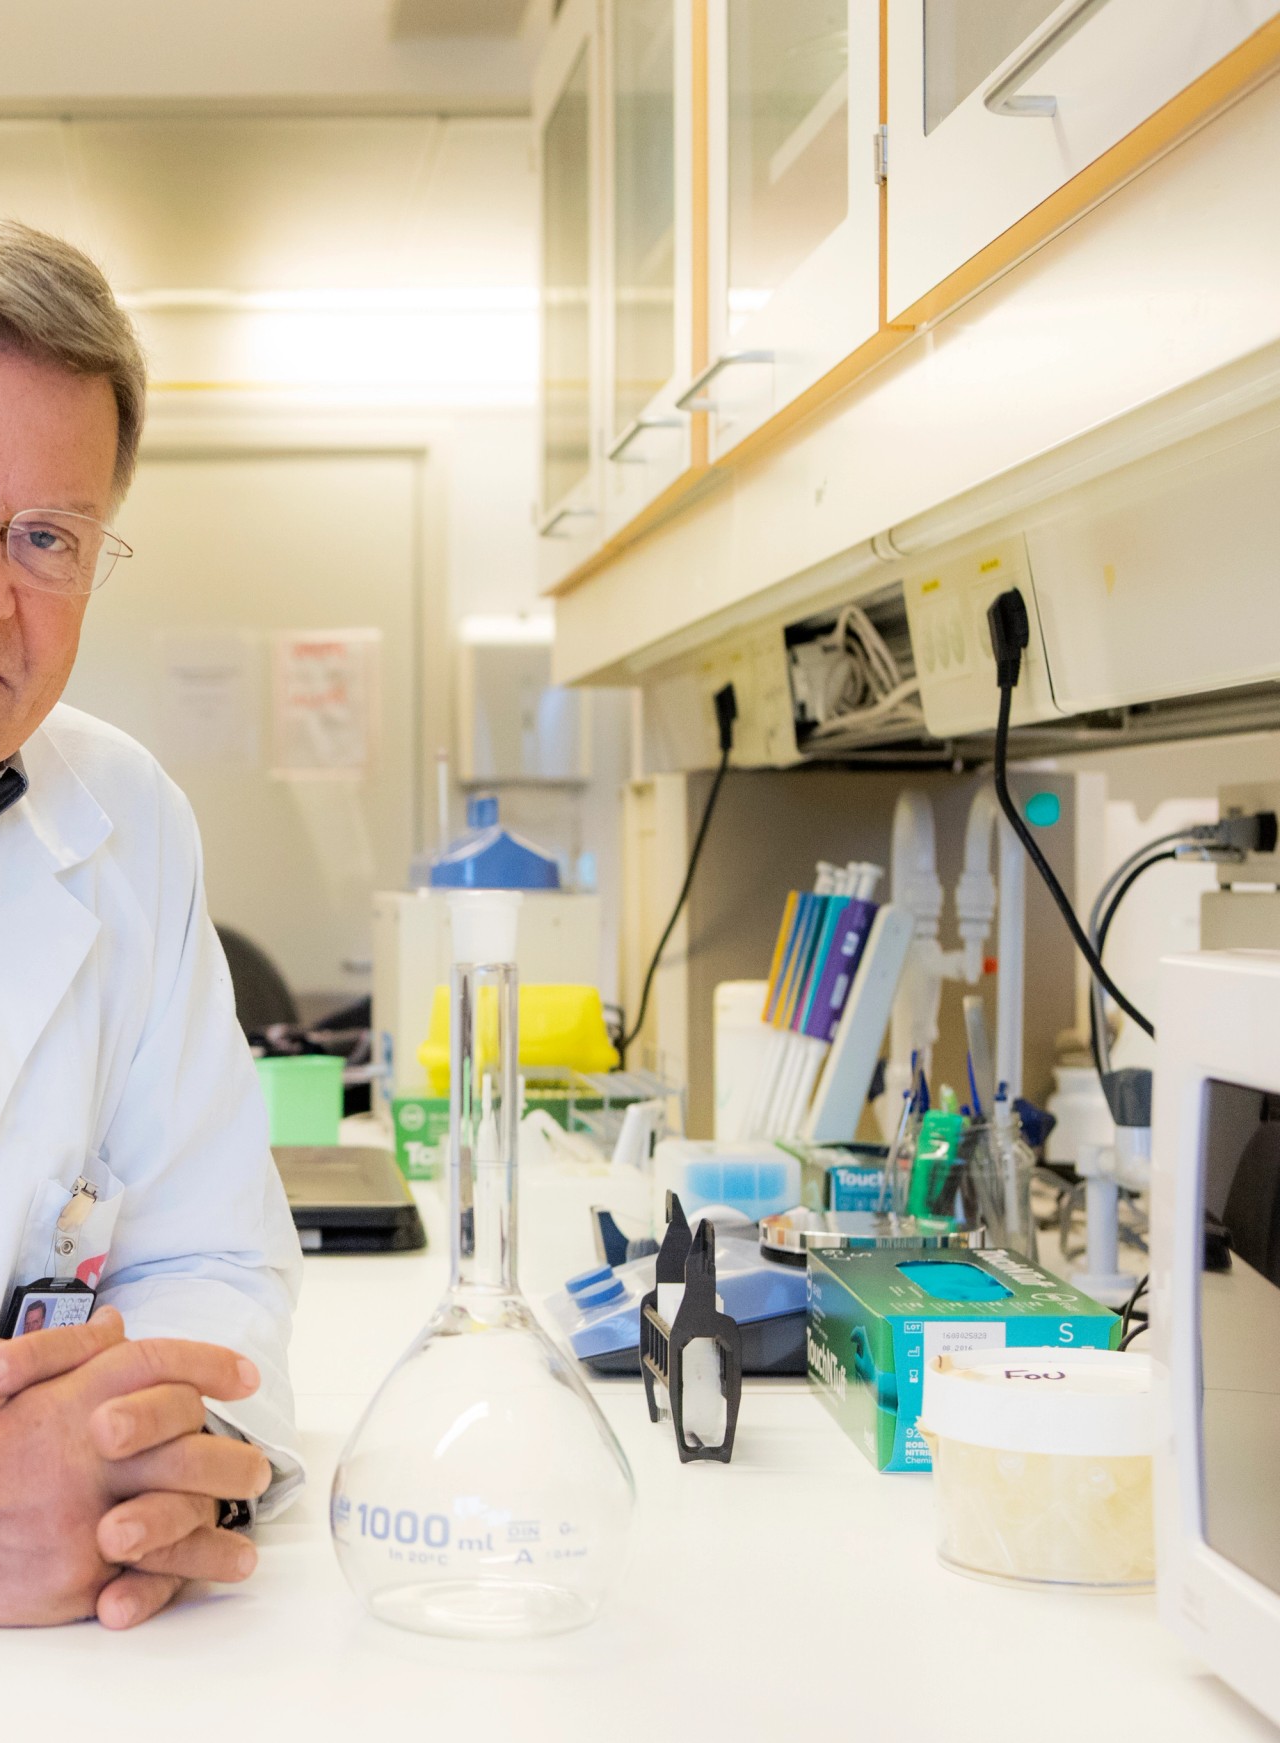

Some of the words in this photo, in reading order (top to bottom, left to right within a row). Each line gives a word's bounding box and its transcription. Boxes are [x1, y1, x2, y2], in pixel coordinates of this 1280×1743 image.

[1058, 1322, 1074, 1343] S
[905, 1456, 933, 1464] Chemi
[358, 1503, 450, 1548] 1000
[458, 1533, 494, 1552] ml
[514, 1548, 534, 1565] A
